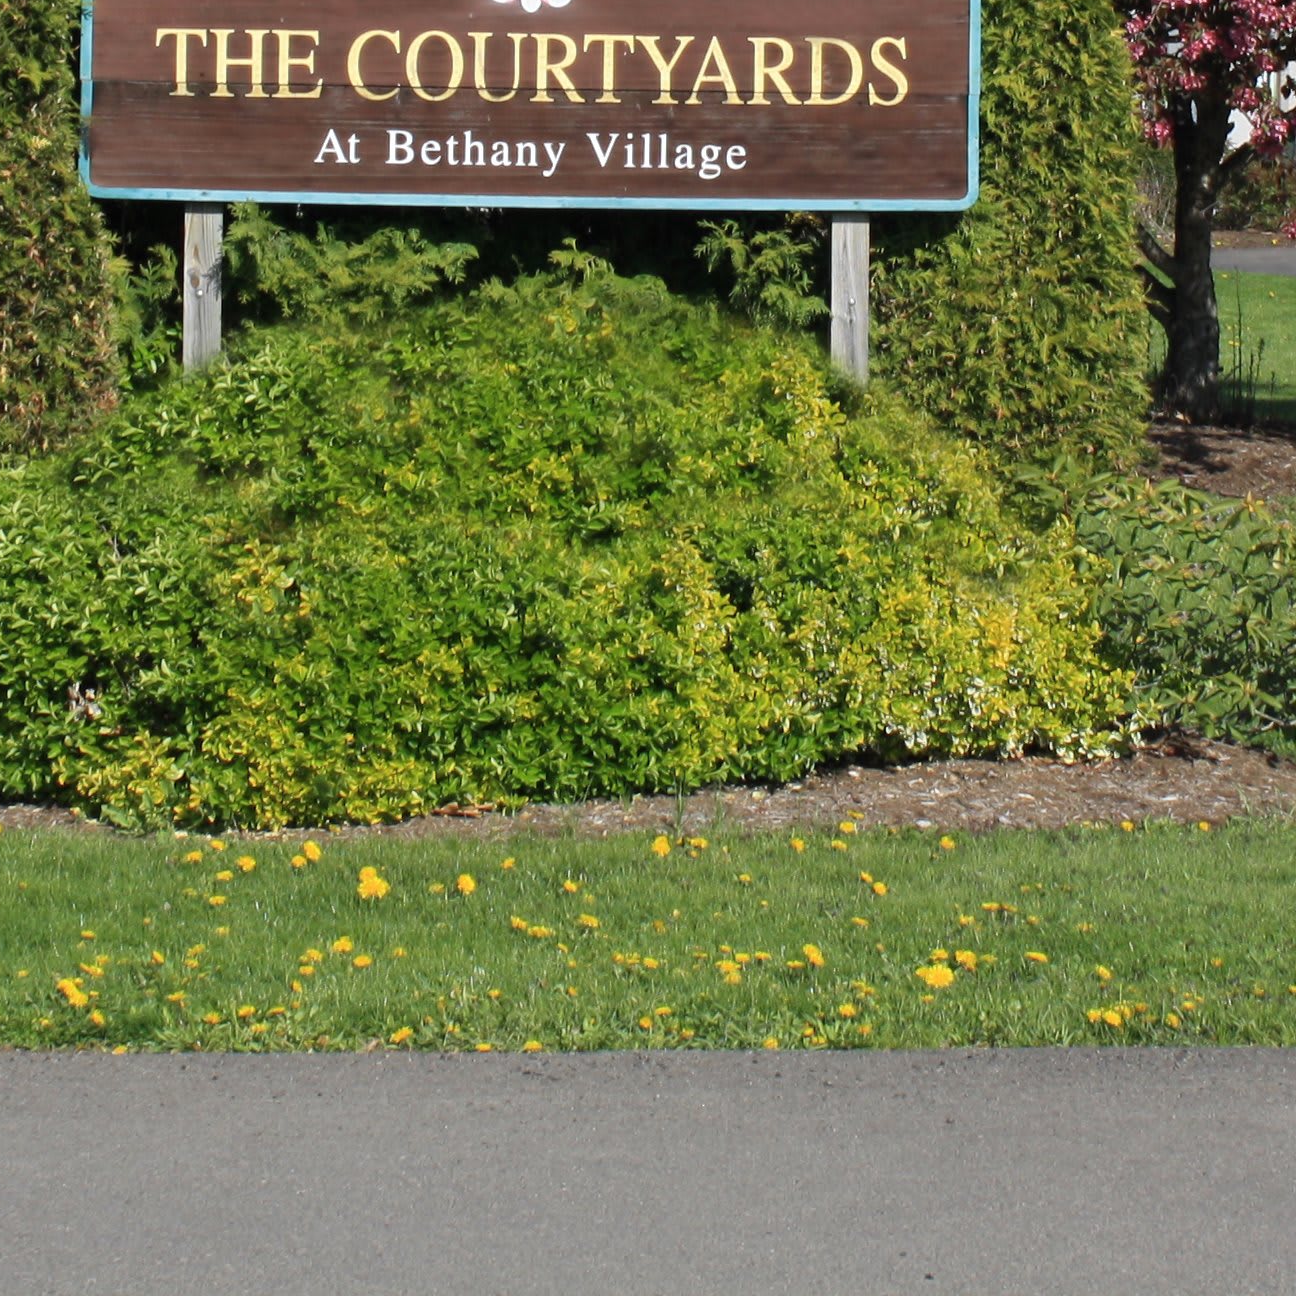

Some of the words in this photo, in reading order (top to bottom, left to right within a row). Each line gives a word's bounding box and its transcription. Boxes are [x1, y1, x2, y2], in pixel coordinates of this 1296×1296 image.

[154, 26, 324, 99] THE
[346, 29, 910, 107] COURTYARDS
[313, 128, 362, 165] At
[384, 129, 566, 178] Bethany
[585, 132, 747, 180] Village
